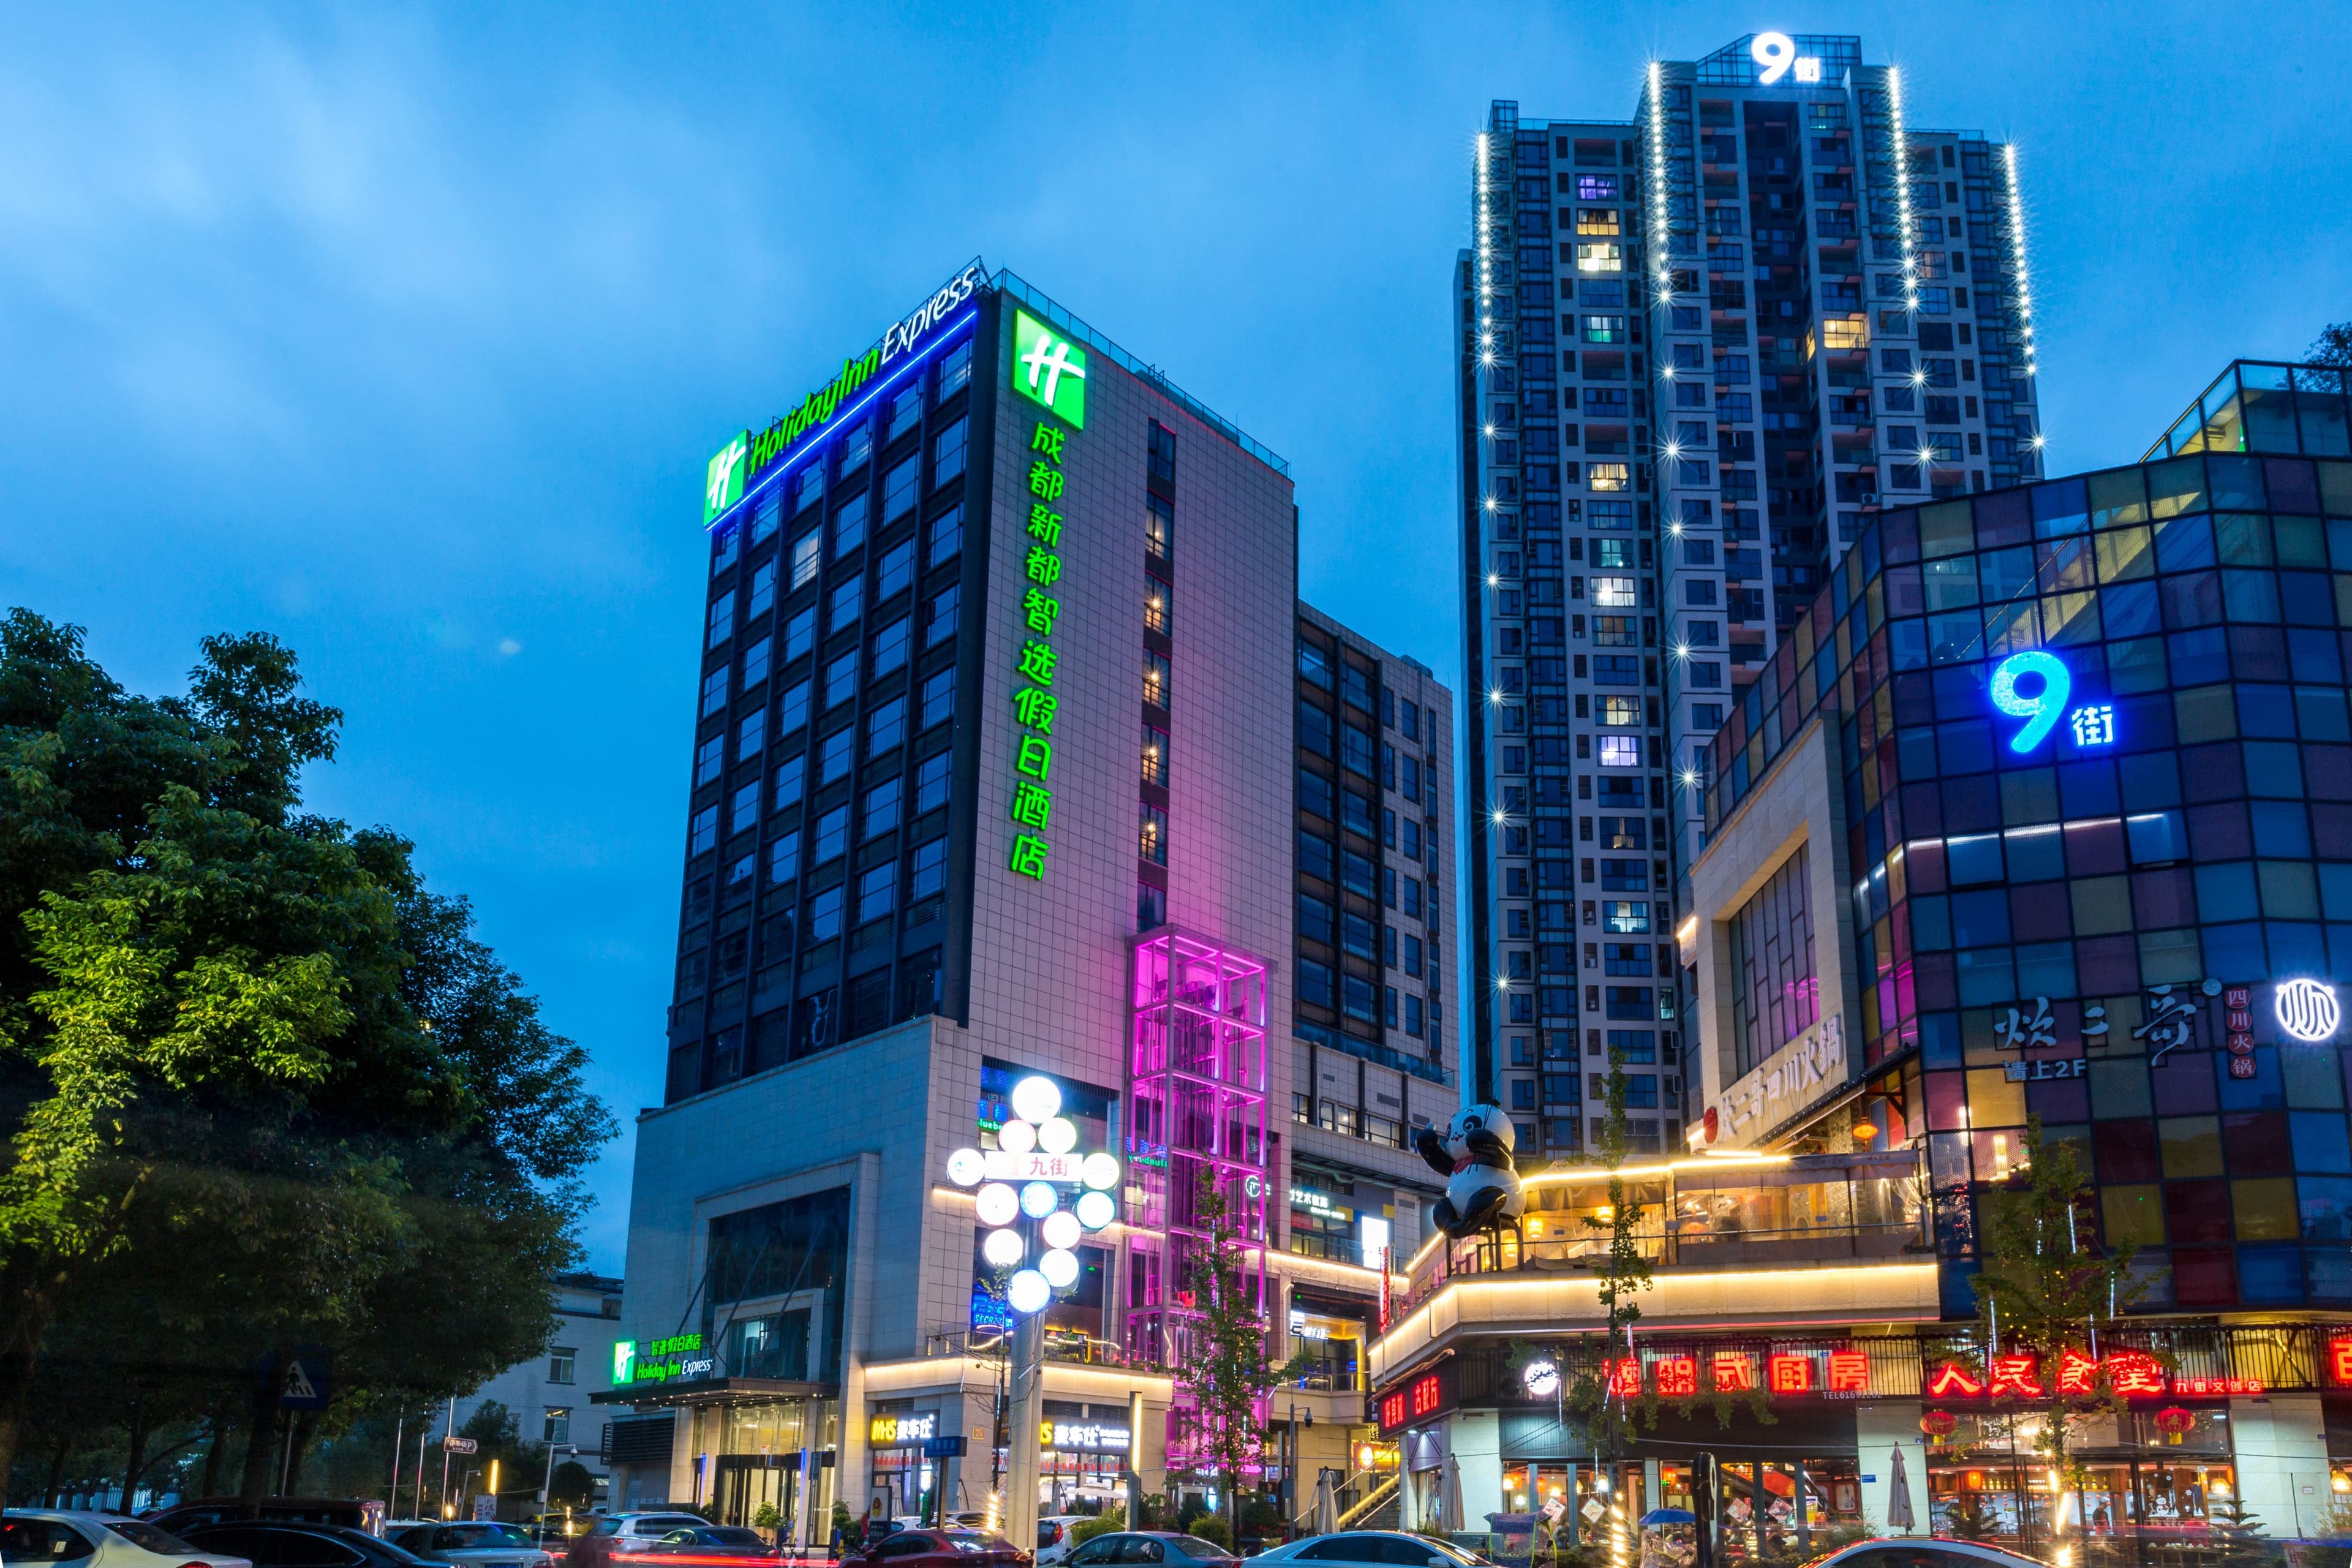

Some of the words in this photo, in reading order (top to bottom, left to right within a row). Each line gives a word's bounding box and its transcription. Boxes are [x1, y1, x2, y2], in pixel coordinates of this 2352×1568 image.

[751, 380, 840, 474] Holiday
[839, 349, 880, 401] Inn
[881, 266, 976, 364] Express
[1010, 421, 1066, 881] 成都新都智选假日酒店
[2227, 989, 2255, 1076] 四川火锅
[2003, 1058, 2087, 1081] 请上2F
[1029, 1156, 1069, 1177] 九街
[651, 1333, 703, 1356] 智选假日酒店
[637, 1362, 667, 1382] Holiday
[668, 1359, 681, 1376] Inn
[682, 1359, 711, 1376] Express
[1932, 1354, 2163, 1395] 人民食堂
[2175, 1380, 2261, 1393] 九街文创店
